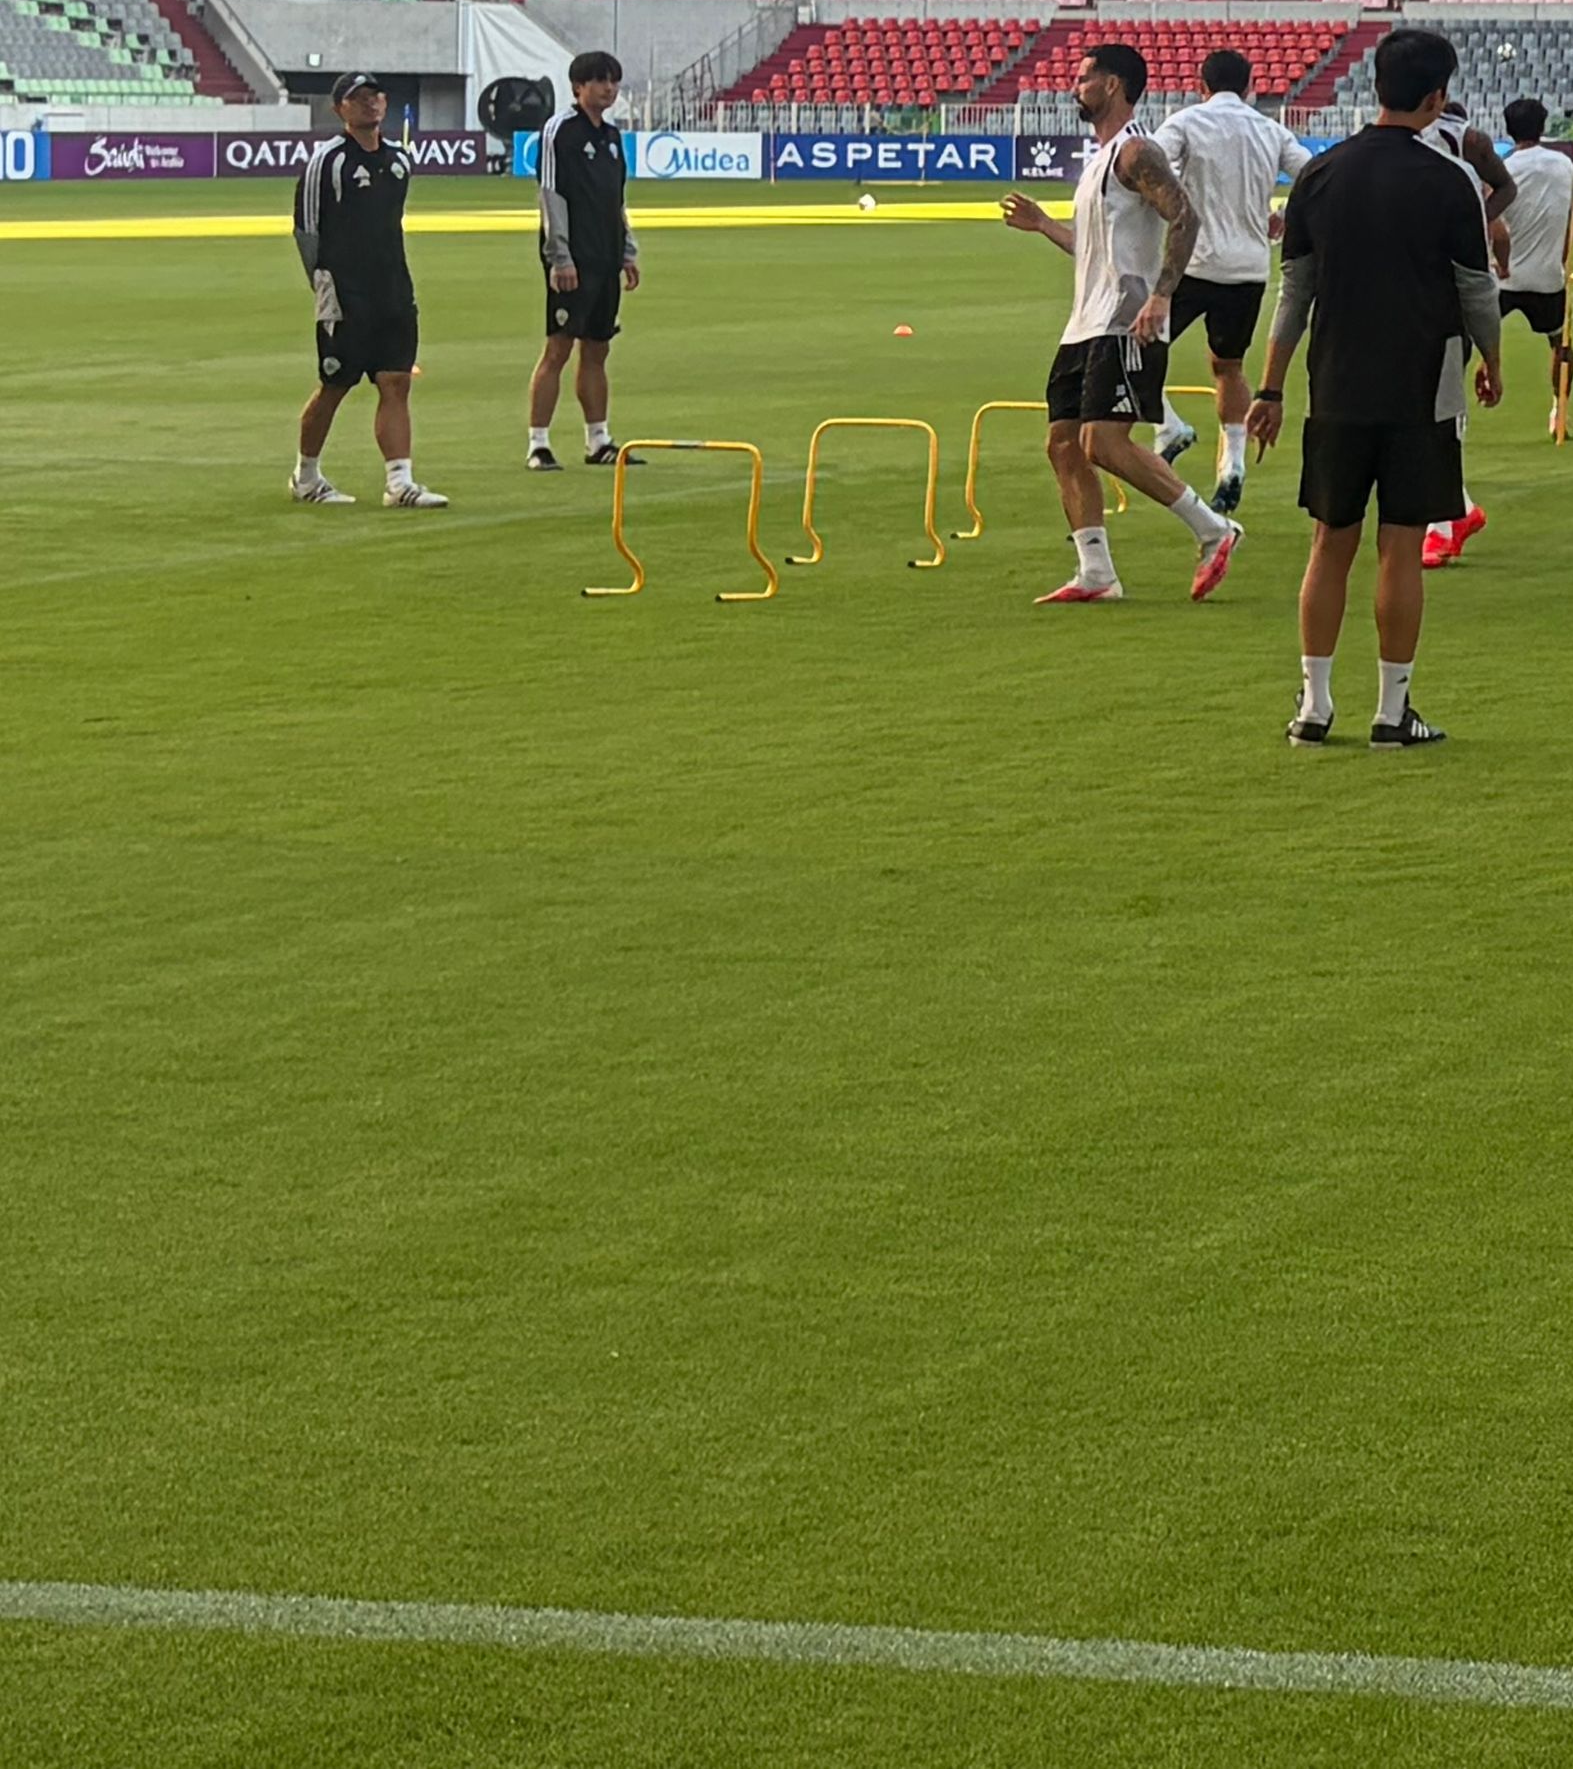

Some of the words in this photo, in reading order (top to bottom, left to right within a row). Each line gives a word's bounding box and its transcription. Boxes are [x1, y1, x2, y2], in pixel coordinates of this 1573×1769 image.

[405, 138, 478, 165] WAYS
[660, 139, 750, 173] Midea
[777, 141, 999, 175] ASPETAR
